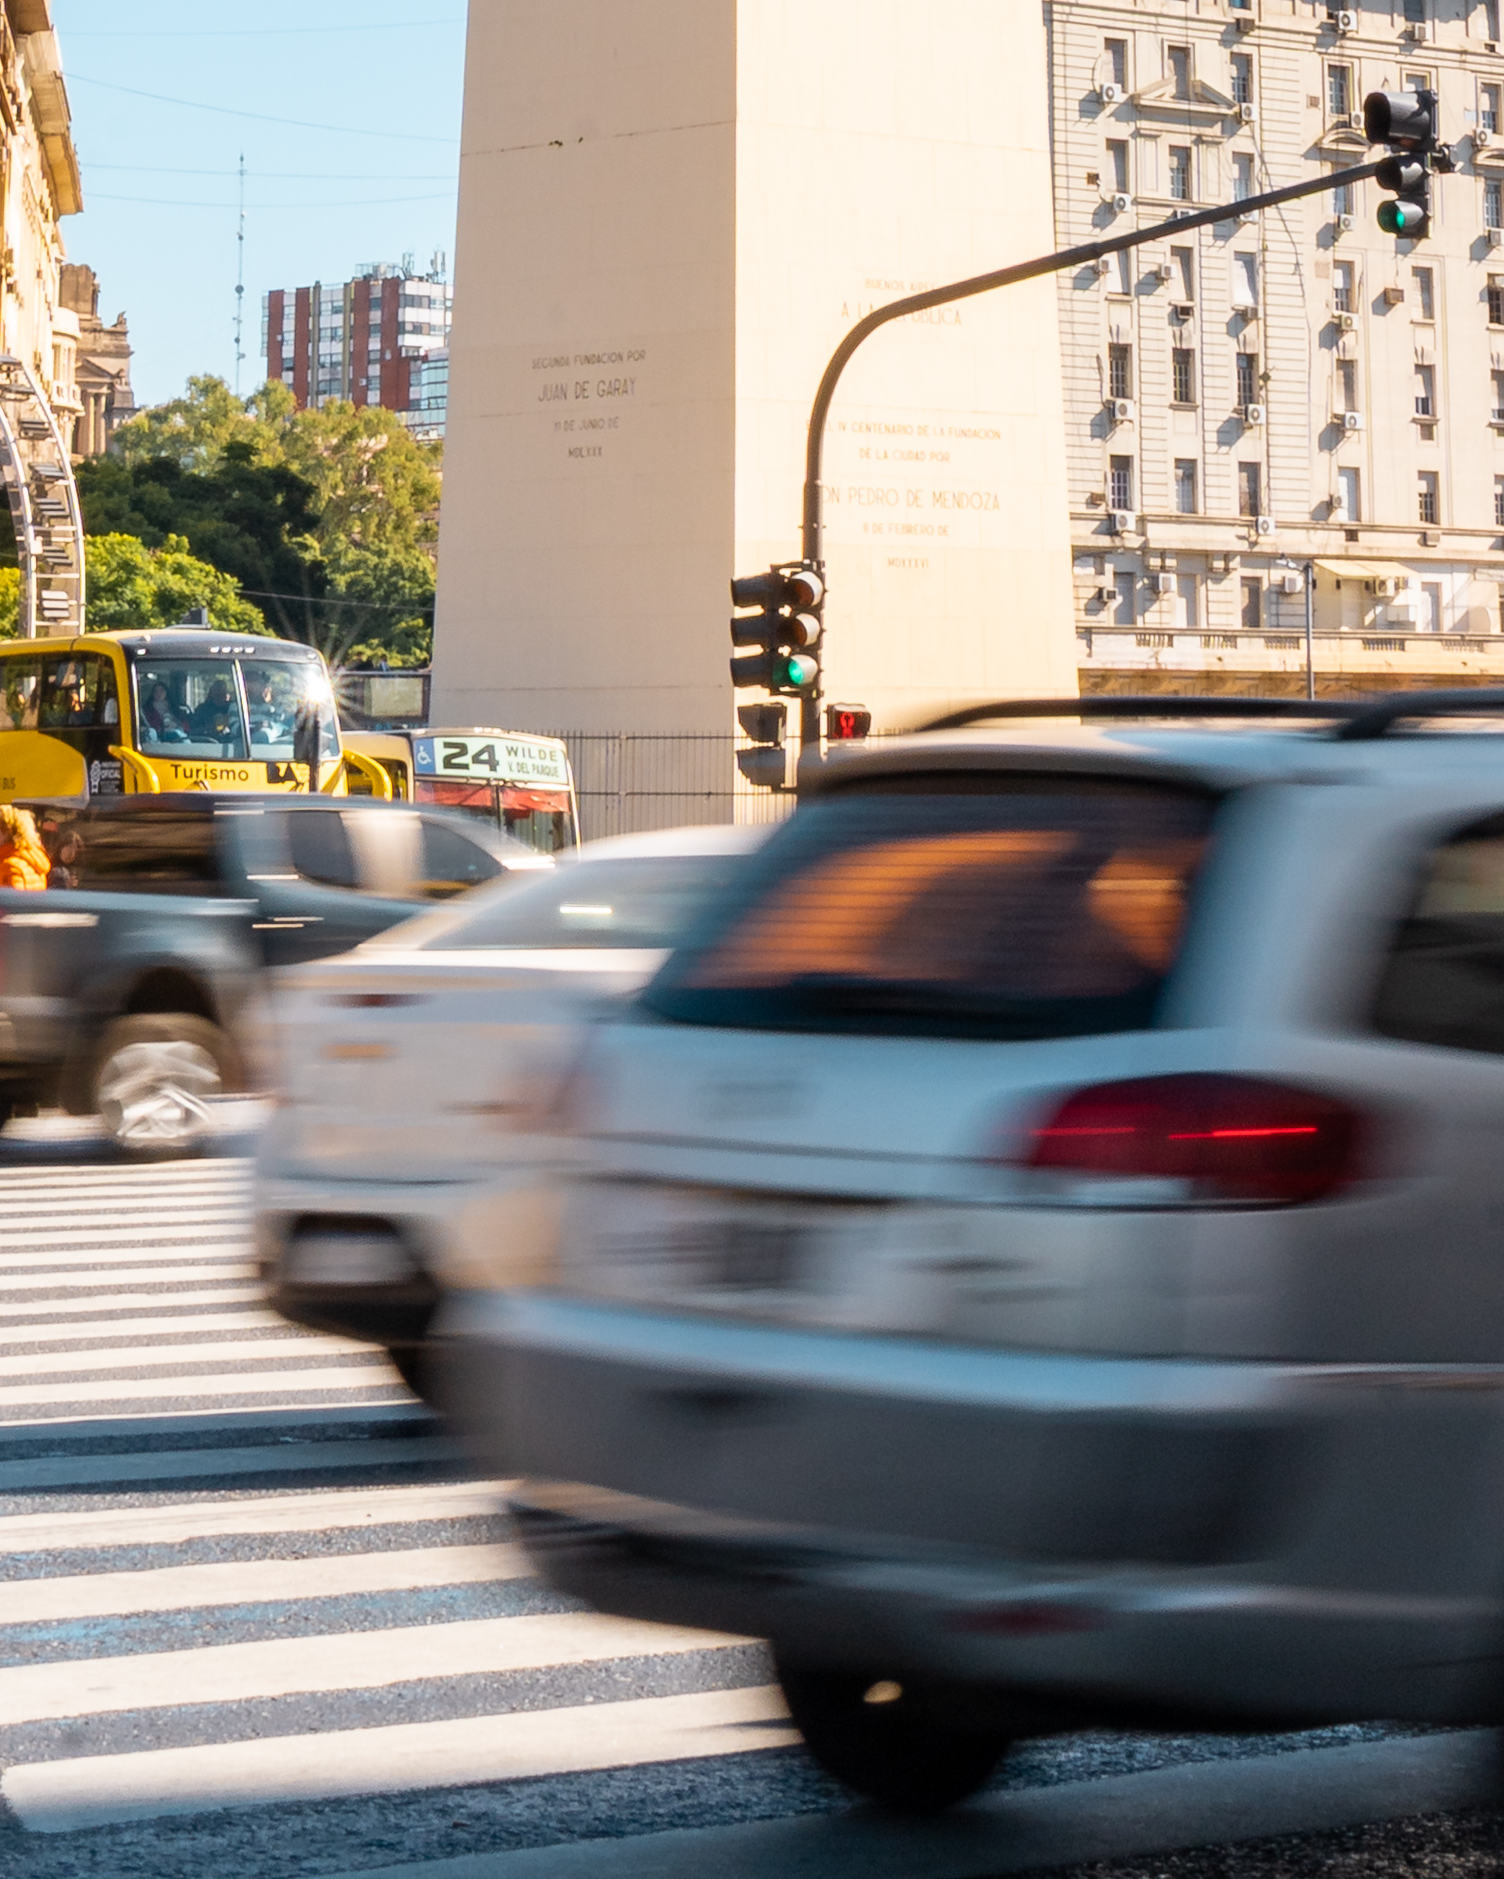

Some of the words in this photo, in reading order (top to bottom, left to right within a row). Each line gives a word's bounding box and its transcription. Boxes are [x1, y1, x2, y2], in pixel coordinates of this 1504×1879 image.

[894, 306, 962, 327] UBLICA
[627, 349, 646, 362] POR
[538, 382, 568, 402] JUAN
[574, 380, 590, 400] DE
[596, 376, 637, 398] GARAY
[848, 486, 899, 507] PEDRO
[906, 488, 924, 508] DE
[932, 490, 1000, 511] MENDOZA
[442, 741, 500, 772] 24
[505, 744, 558, 762] WILDE
[170, 763, 249, 782] Turismo
[532, 763, 559, 778] PARQUE
